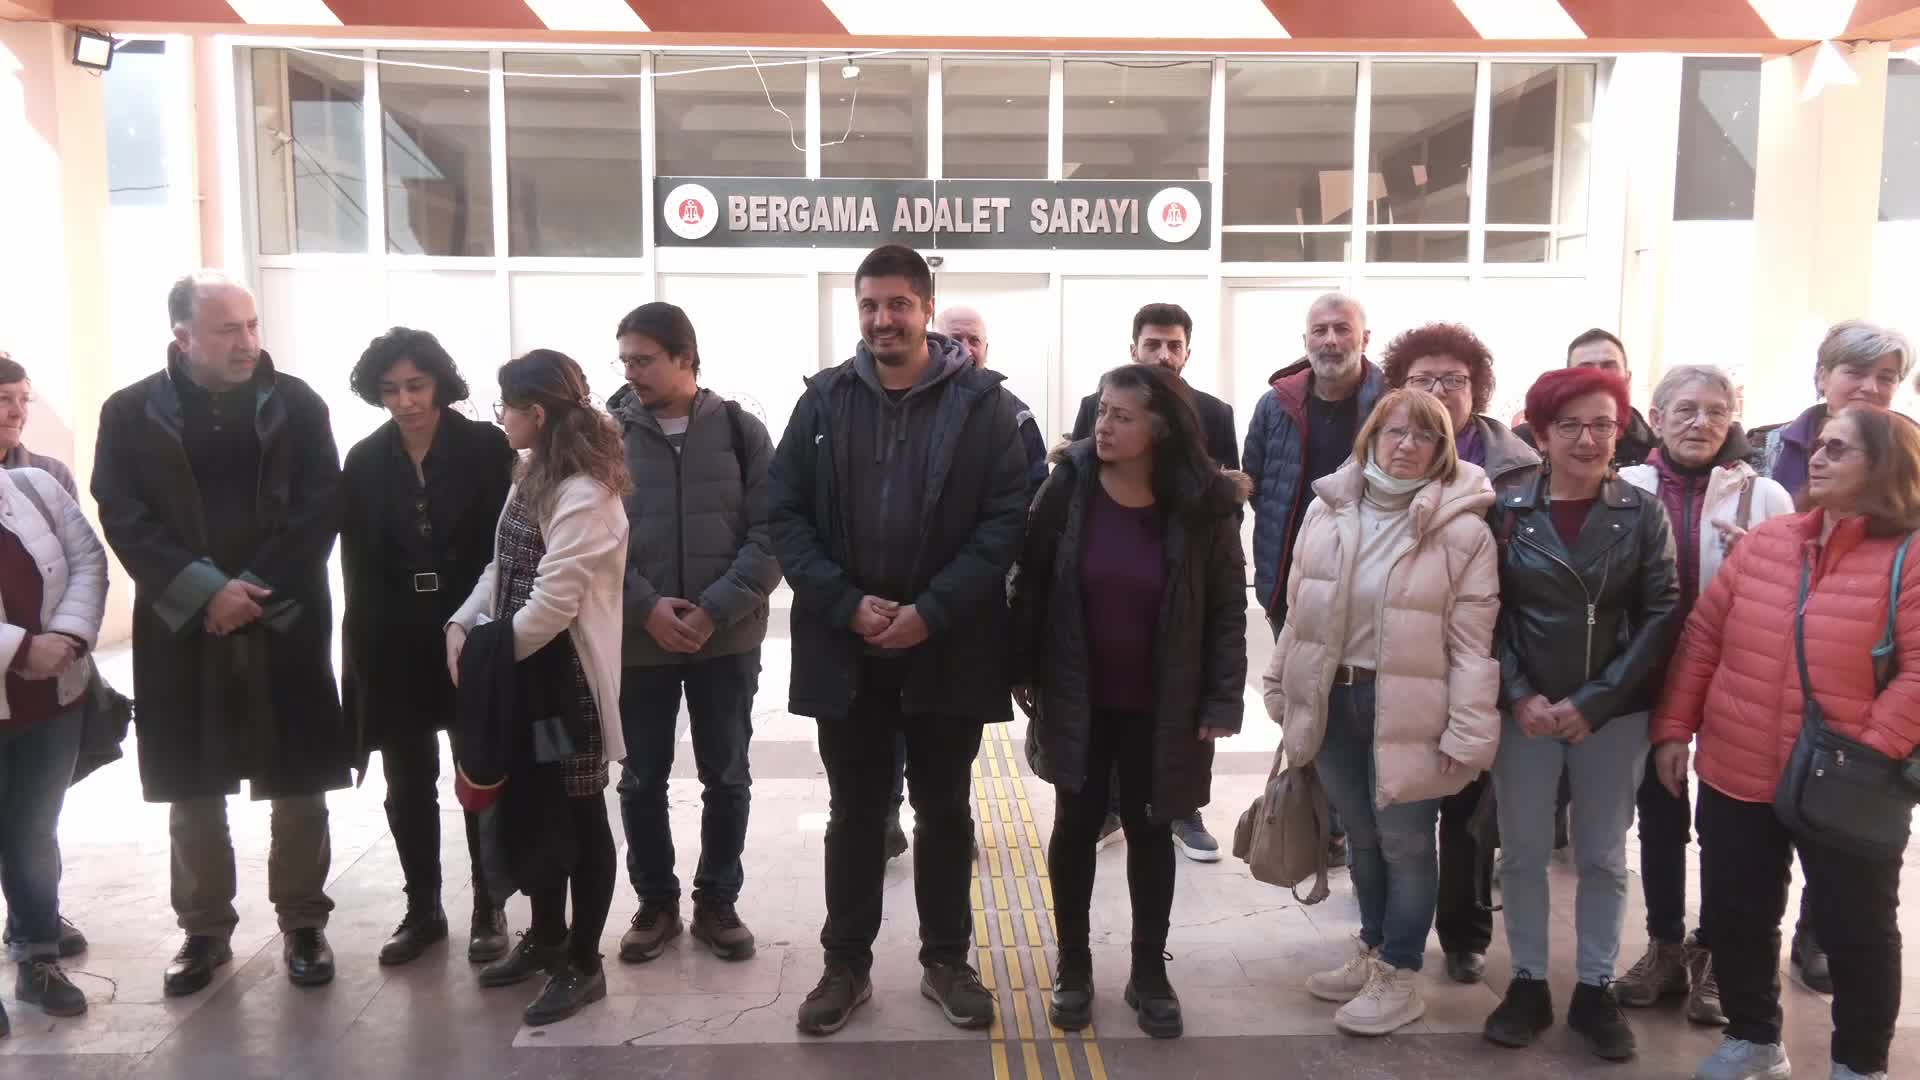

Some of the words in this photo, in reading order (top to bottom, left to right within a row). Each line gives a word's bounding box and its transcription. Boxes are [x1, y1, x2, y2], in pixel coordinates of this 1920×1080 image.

[728, 195, 880, 232] BERGAMA
[892, 197, 1011, 233] ADALET
[1030, 198, 1139, 234] SARAYI
